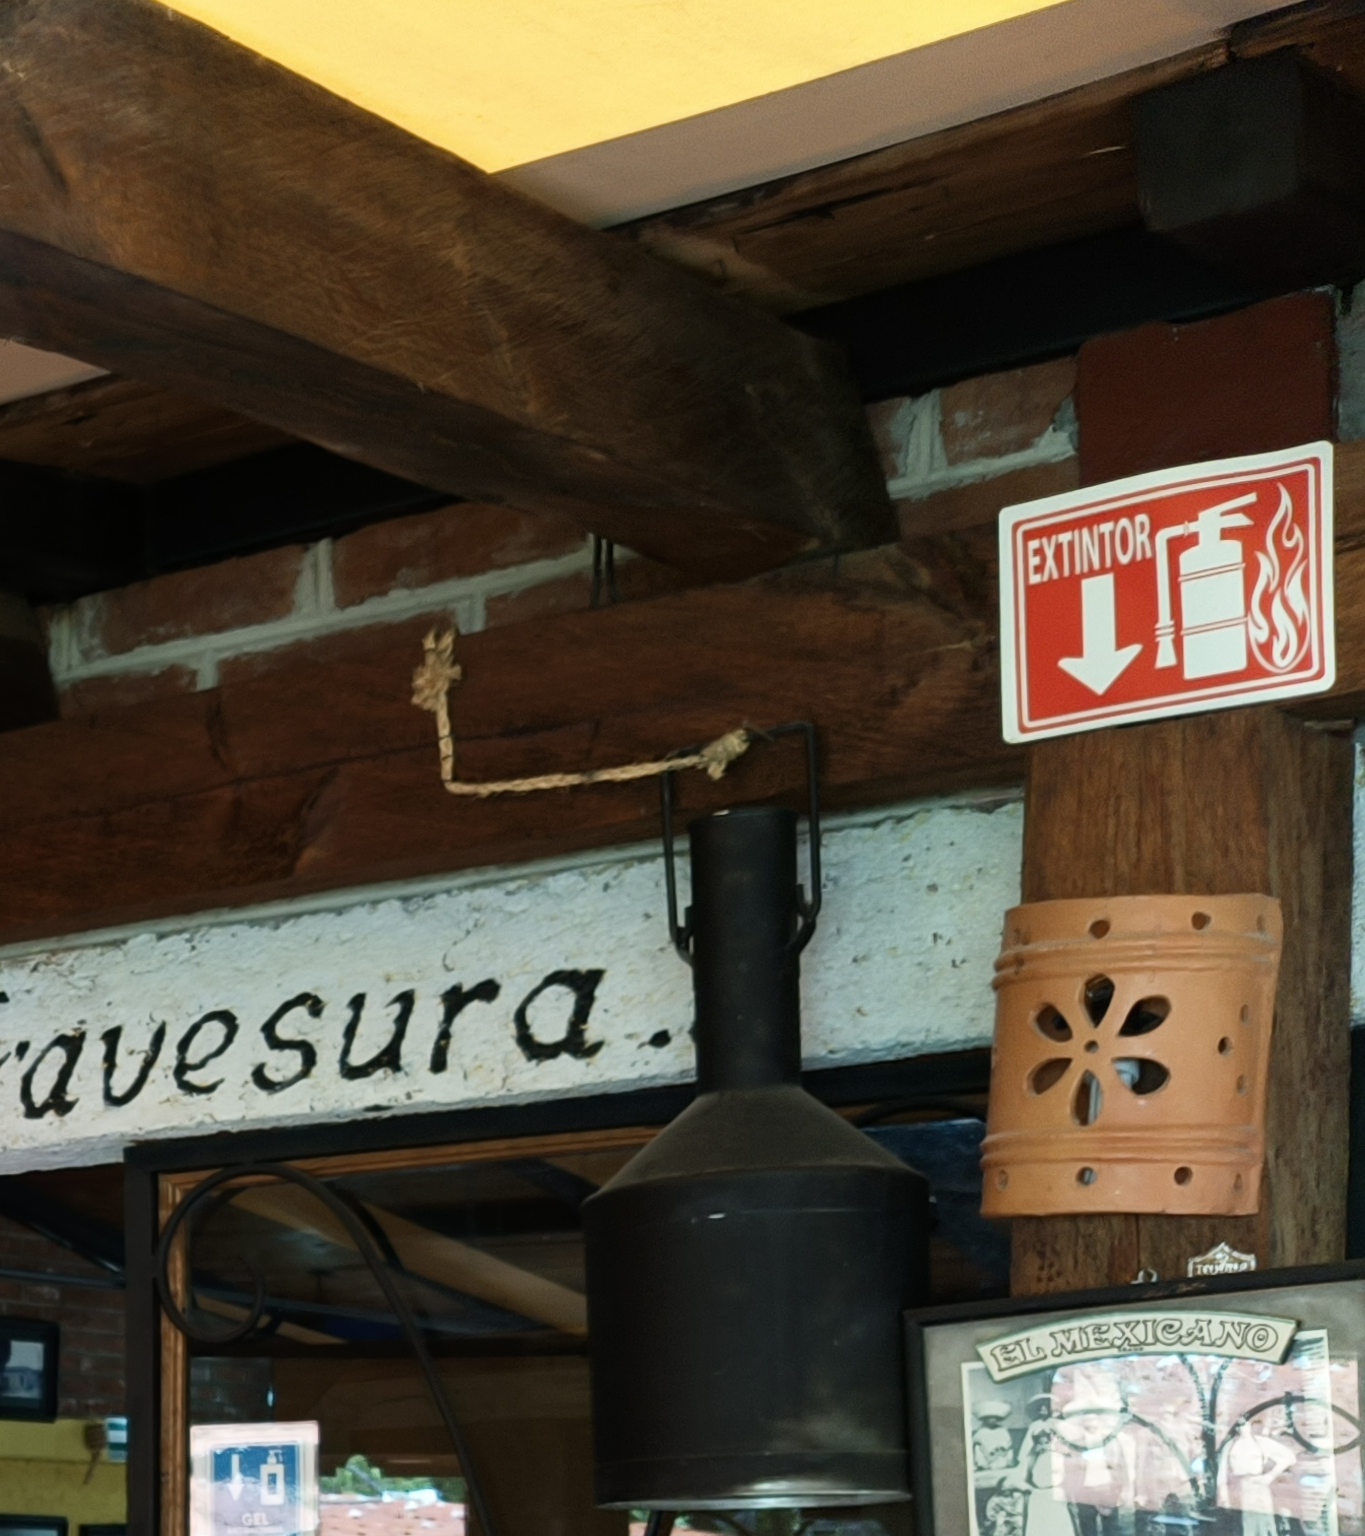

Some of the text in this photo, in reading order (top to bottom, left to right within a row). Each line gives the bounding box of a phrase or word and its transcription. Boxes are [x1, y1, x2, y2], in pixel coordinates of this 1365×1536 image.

[1026, 513, 1152, 586] EXTINTOR
[988, 1317, 1280, 1373] EL MEXICANO
[241, 1512, 269, 1526] GEL
